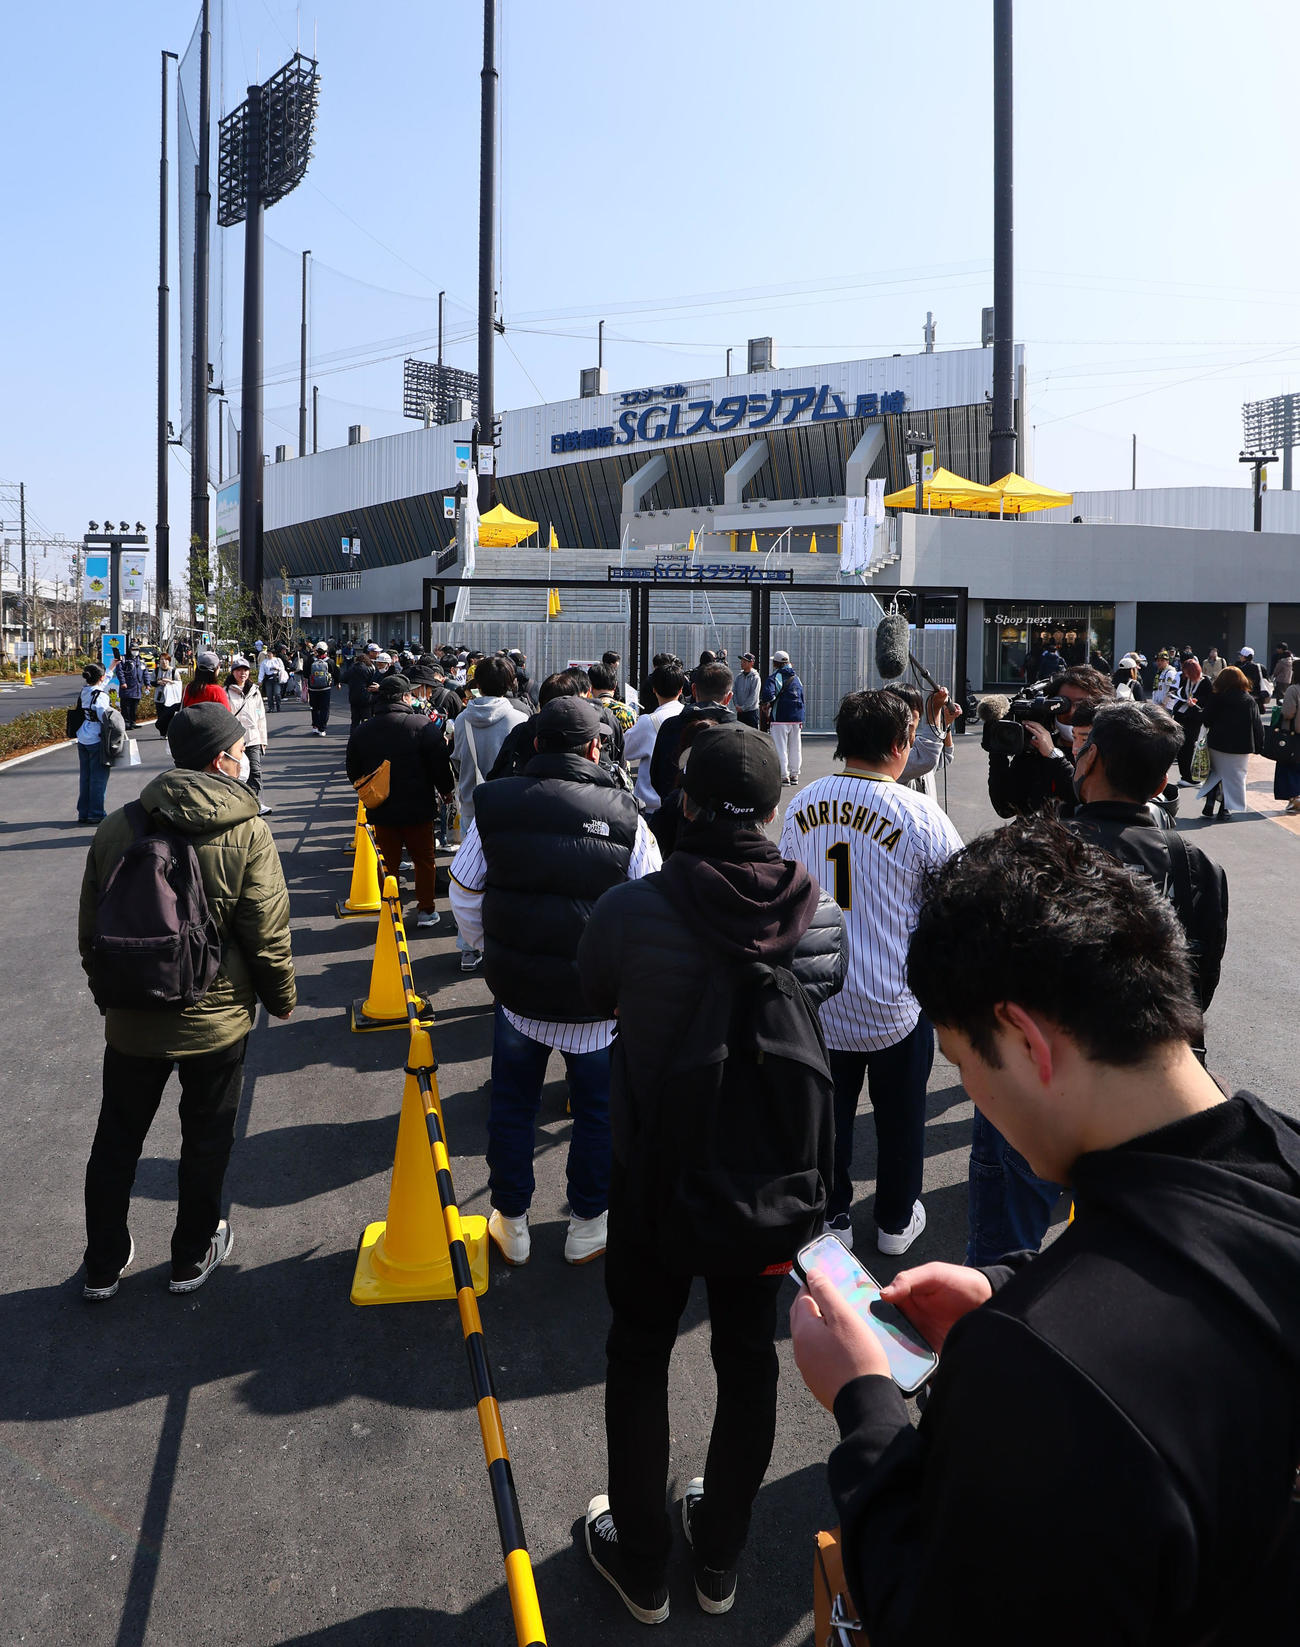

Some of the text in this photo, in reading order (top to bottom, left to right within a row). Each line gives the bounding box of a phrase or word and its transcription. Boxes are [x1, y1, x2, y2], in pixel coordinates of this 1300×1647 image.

[620, 384, 687, 405] エスジーエル
[616, 385, 848, 445] SGLスタジアム
[855, 390, 905, 417] 尼崎
[994, 614, 1023, 626] Shop
[1025, 616, 1053, 624] next
[723, 801, 755, 814] Tigers
[795, 800, 904, 853] MORISHITA
[826, 841, 851, 911] 1
